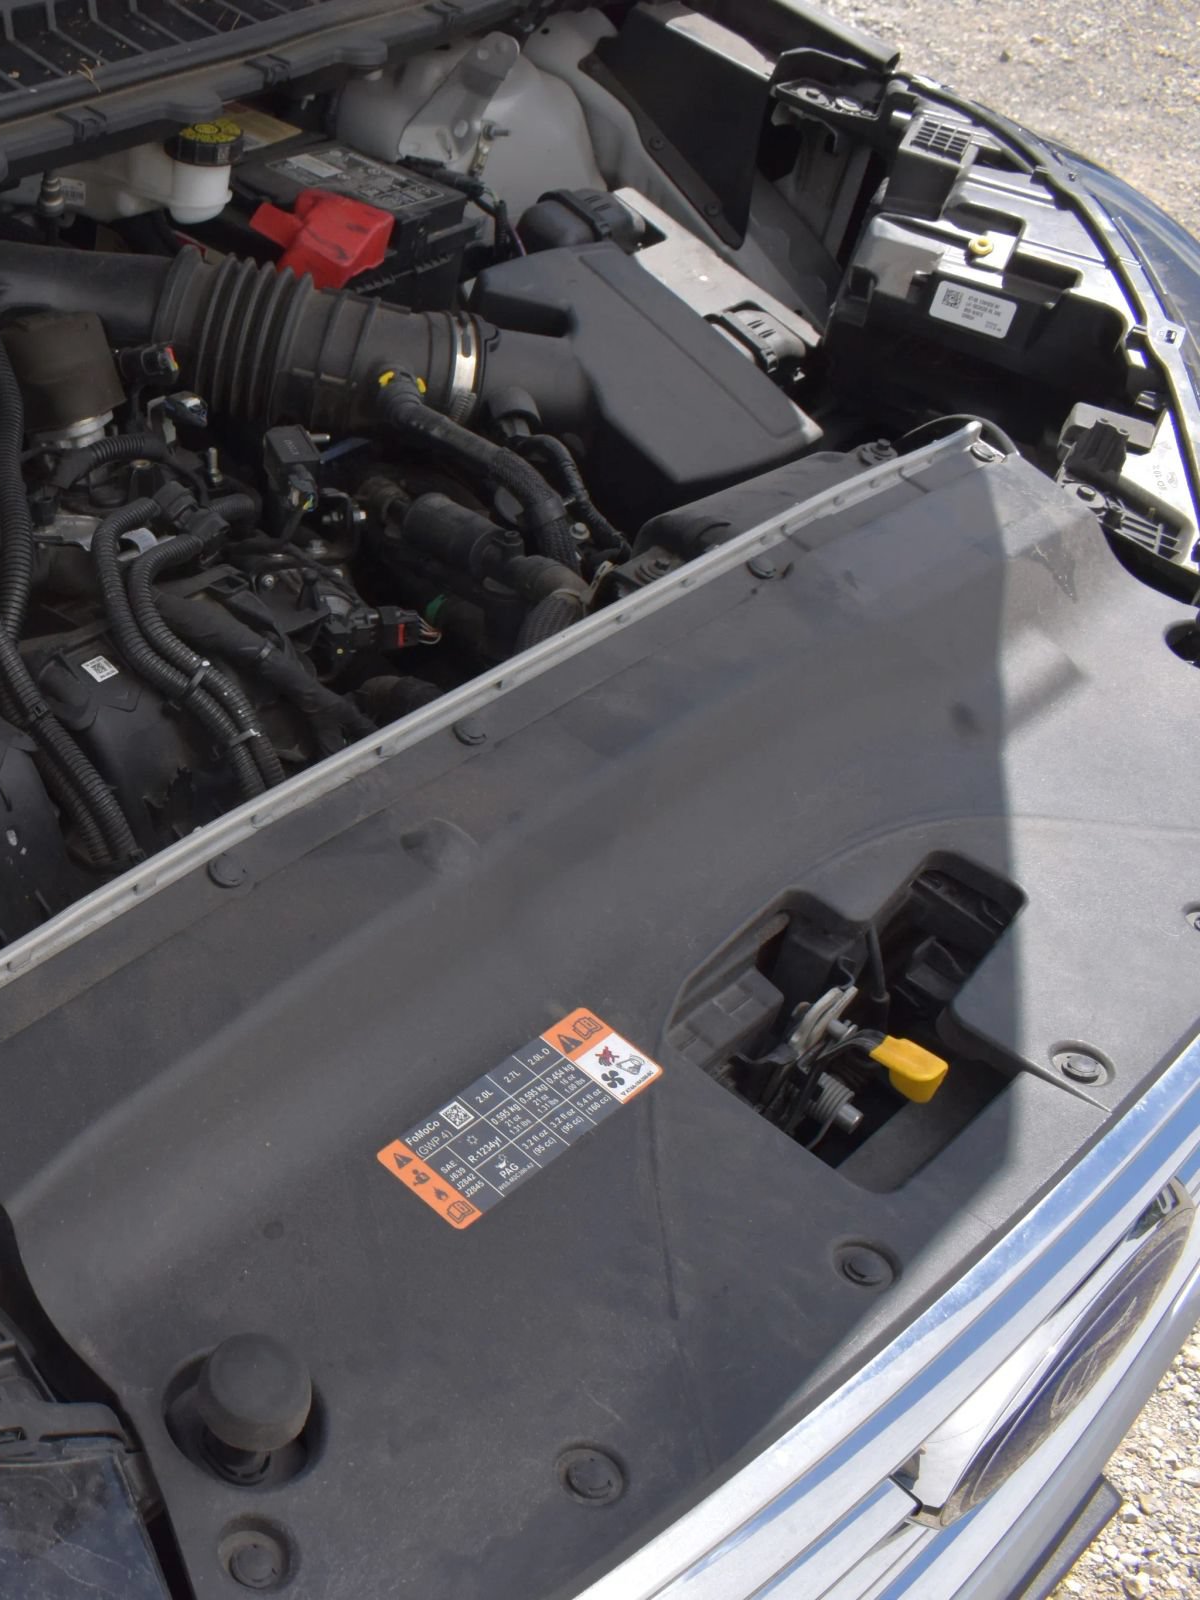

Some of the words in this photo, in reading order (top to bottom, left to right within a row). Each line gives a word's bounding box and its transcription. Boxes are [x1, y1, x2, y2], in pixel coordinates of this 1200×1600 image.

[527, 1053, 544, 1066] 2.0L
[503, 1070, 521, 1083] 2.7L
[546, 1069, 564, 1084] 0.454
[563, 1064, 575, 1072] kg
[567, 1073, 576, 1081] oz
[475, 1089, 494, 1103] 2.0L
[519, 1088, 538, 1104] 0.595
[535, 1083, 549, 1092] kg
[532, 1098, 542, 1106] 21
[576, 1097, 588, 1108] 5.4
[585, 1093, 594, 1101] fl
[592, 1088, 602, 1097] oz
[490, 1108, 511, 1125] 0.595
[508, 1103, 522, 1113] kg
[537, 1103, 551, 1114] 1.31
[585, 1102, 601, 1116] (160
[600, 1094, 612, 1105] cc)
[504, 1119, 513, 1127] 21
[550, 1116, 563, 1128] 3.2
[560, 1112, 568, 1120] fl
[567, 1108, 576, 1116] oz
[561, 1122, 573, 1134] (95
[572, 1115, 585, 1126] cc)
[405, 1120, 440, 1146] FoMoCo
[509, 1124, 522, 1135] 1.31
[415, 1136, 440, 1158] (GWP
[441, 1129, 454, 1140] 4)
[521, 1138, 535, 1150] 3.2
[532, 1133, 541, 1141] fl
[540, 1129, 549, 1138] oz
[533, 1143, 545, 1156] (95
[544, 1136, 558, 1147] cc)
[467, 1136, 503, 1164] R-1234yf
[440, 1160, 458, 1174] SAE
[449, 1167, 467, 1182] J639
[499, 1162, 519, 1179] PAG
[455, 1173, 477, 1191] J2842
[464, 1180, 485, 1198] J2845
